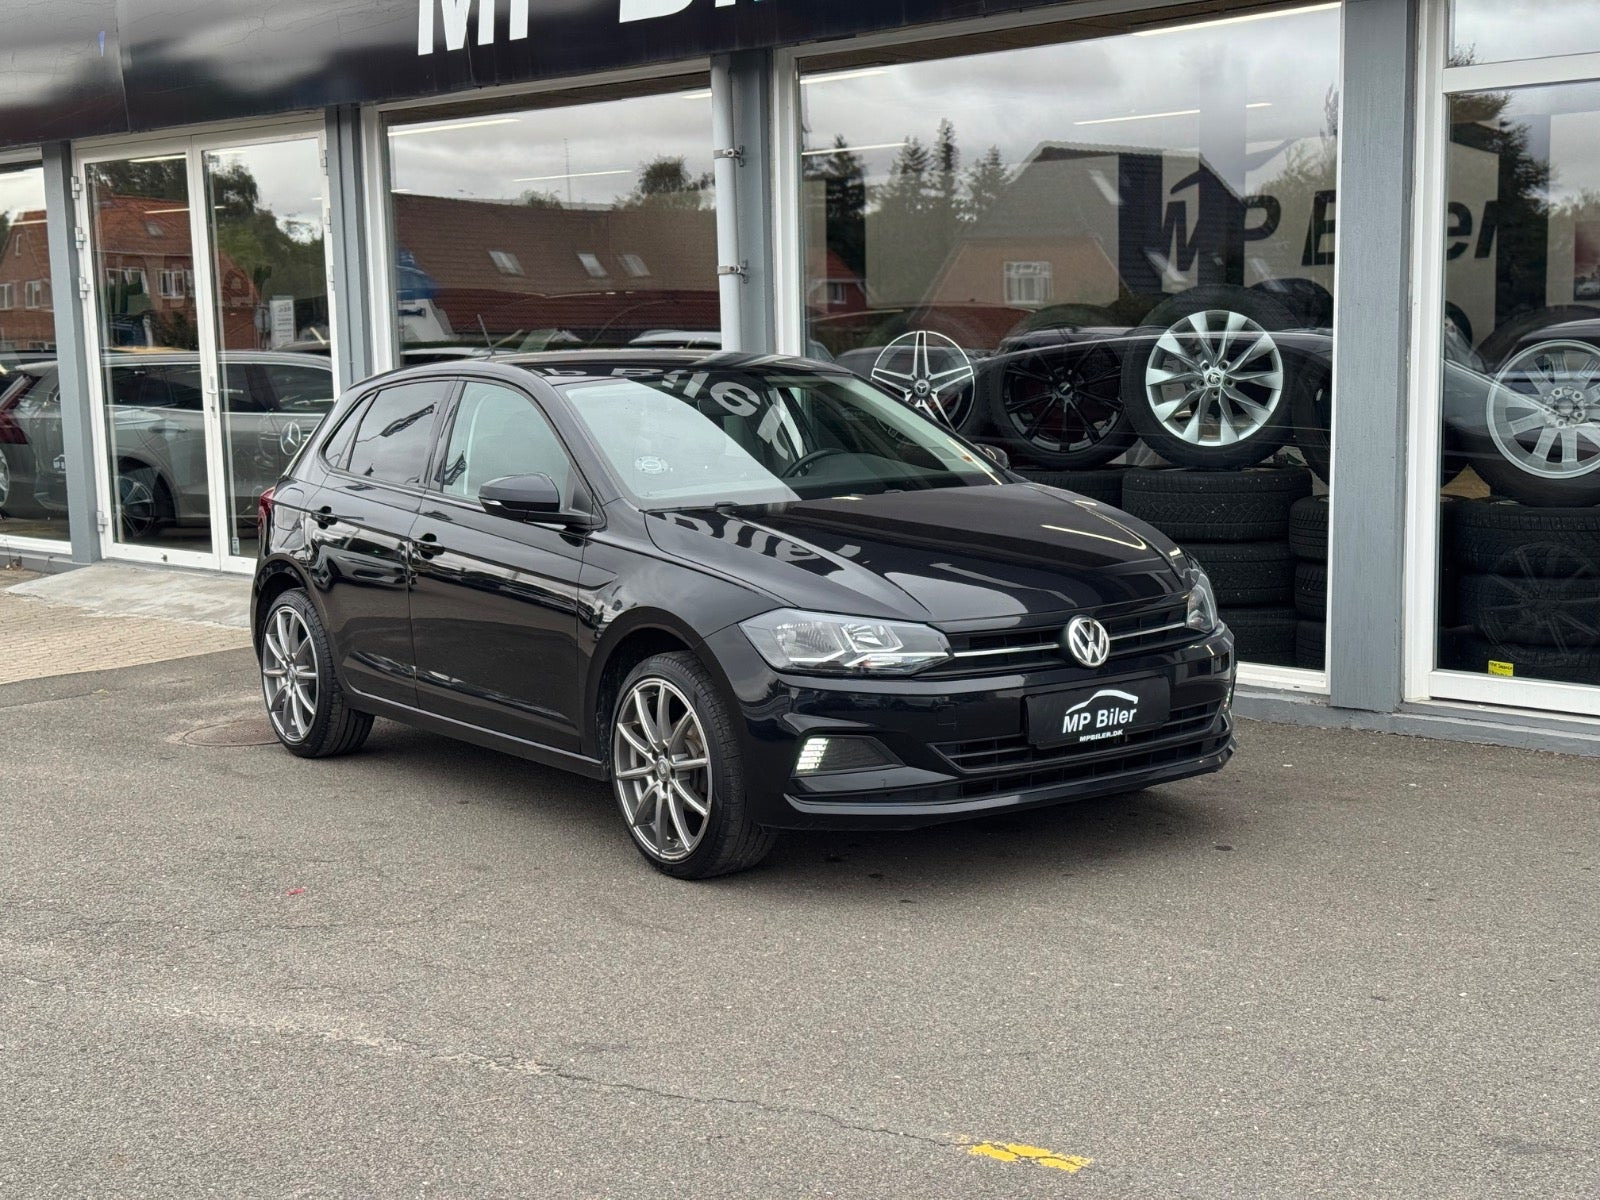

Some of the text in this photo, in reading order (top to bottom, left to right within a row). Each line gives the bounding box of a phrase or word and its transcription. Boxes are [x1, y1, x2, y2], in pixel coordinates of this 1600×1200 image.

[1062, 707, 1137, 734] MP Biler
[1079, 729, 1124, 742] MPBILER.DK
